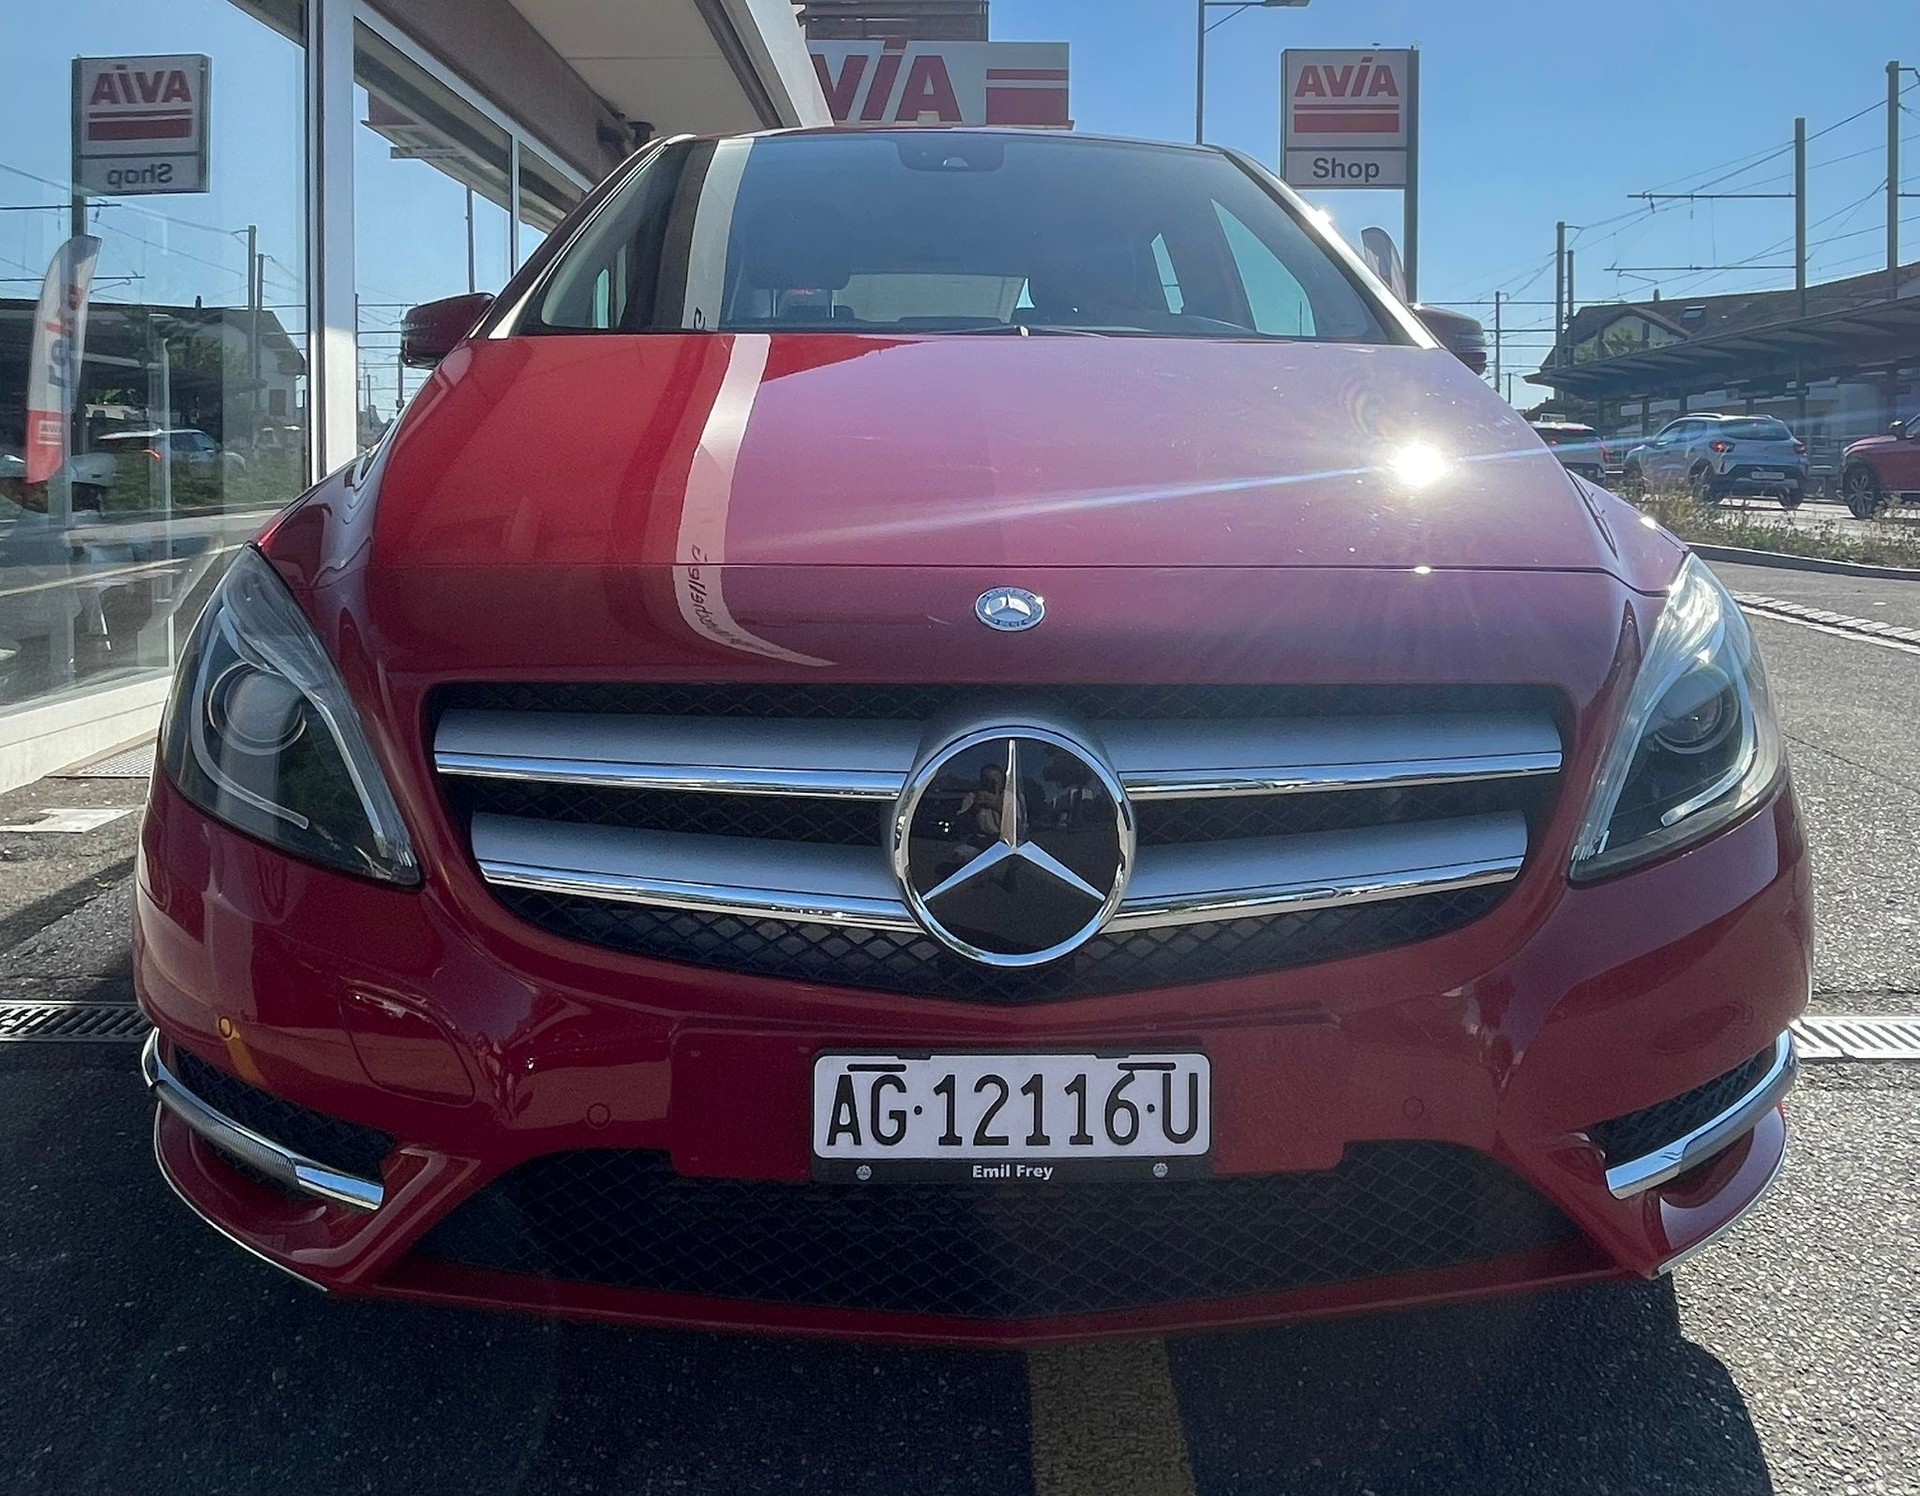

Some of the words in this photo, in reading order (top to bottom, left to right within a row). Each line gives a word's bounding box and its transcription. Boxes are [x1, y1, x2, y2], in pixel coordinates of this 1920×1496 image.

[810, 37, 963, 122] VIA
[1294, 56, 1399, 98] AVIA
[1312, 157, 1380, 183] Shop
[972, 1164, 1010, 1178] Emil
[1016, 1164, 1054, 1181] Frey
